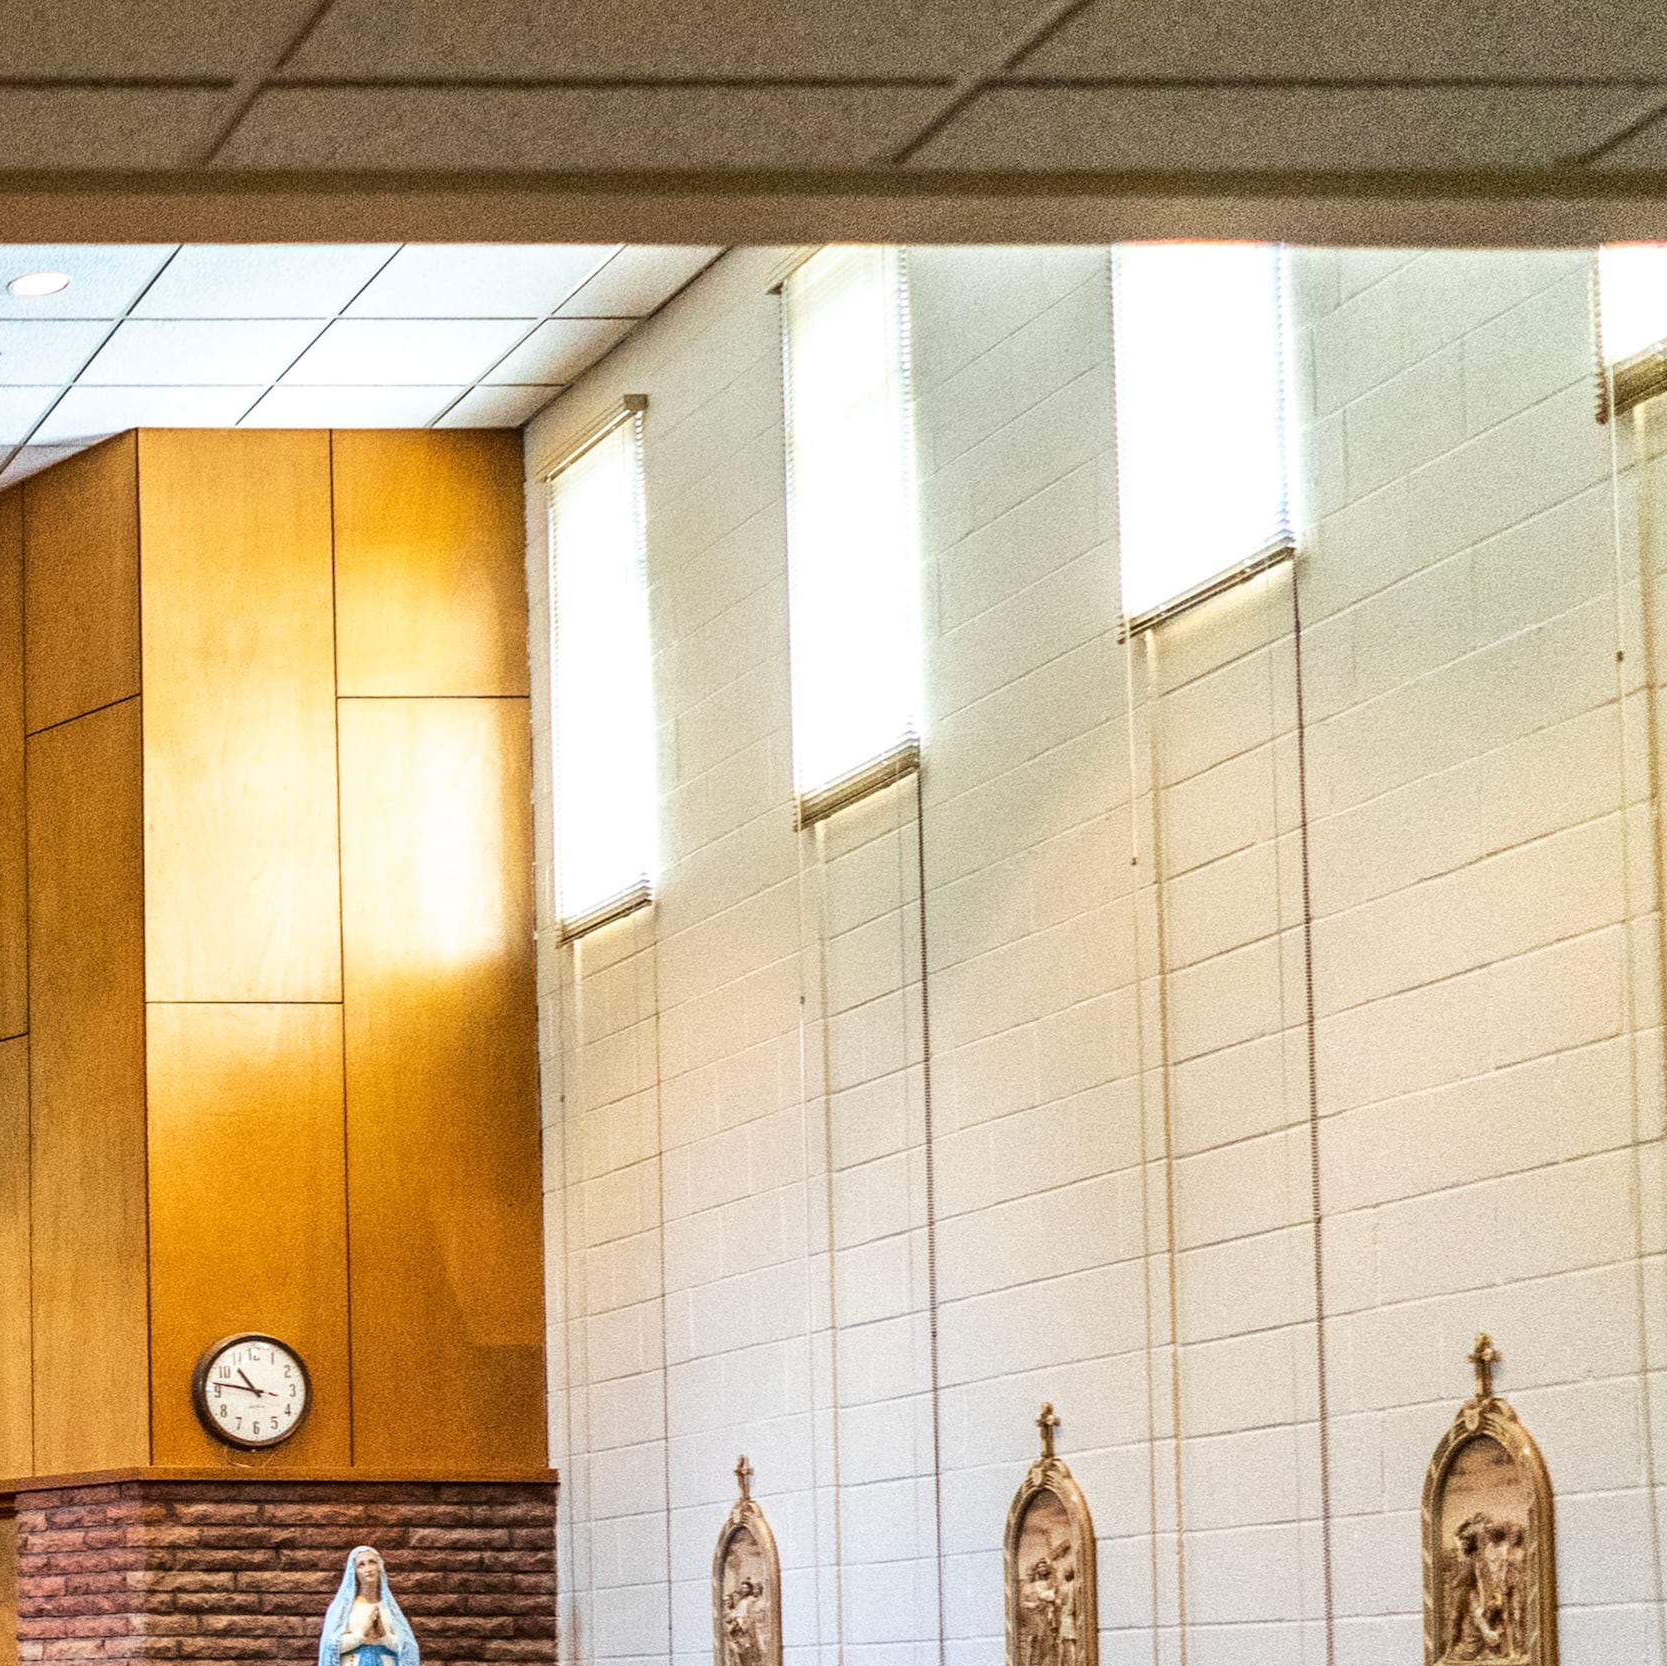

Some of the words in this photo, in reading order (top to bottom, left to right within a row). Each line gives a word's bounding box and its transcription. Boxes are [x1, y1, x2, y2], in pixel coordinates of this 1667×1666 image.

[270, 1351, 275, 1365] 1
[218, 1366, 231, 1379] 10
[283, 1364, 292, 1378] 2
[214, 1385, 222, 1398] 9
[288, 1383, 296, 1397] 3
[220, 1404, 227, 1418] 8
[284, 1403, 291, 1417] 4
[235, 1416, 242, 1430] 7
[253, 1421, 260, 1434] 6
[270, 1416, 278, 1430] 5
